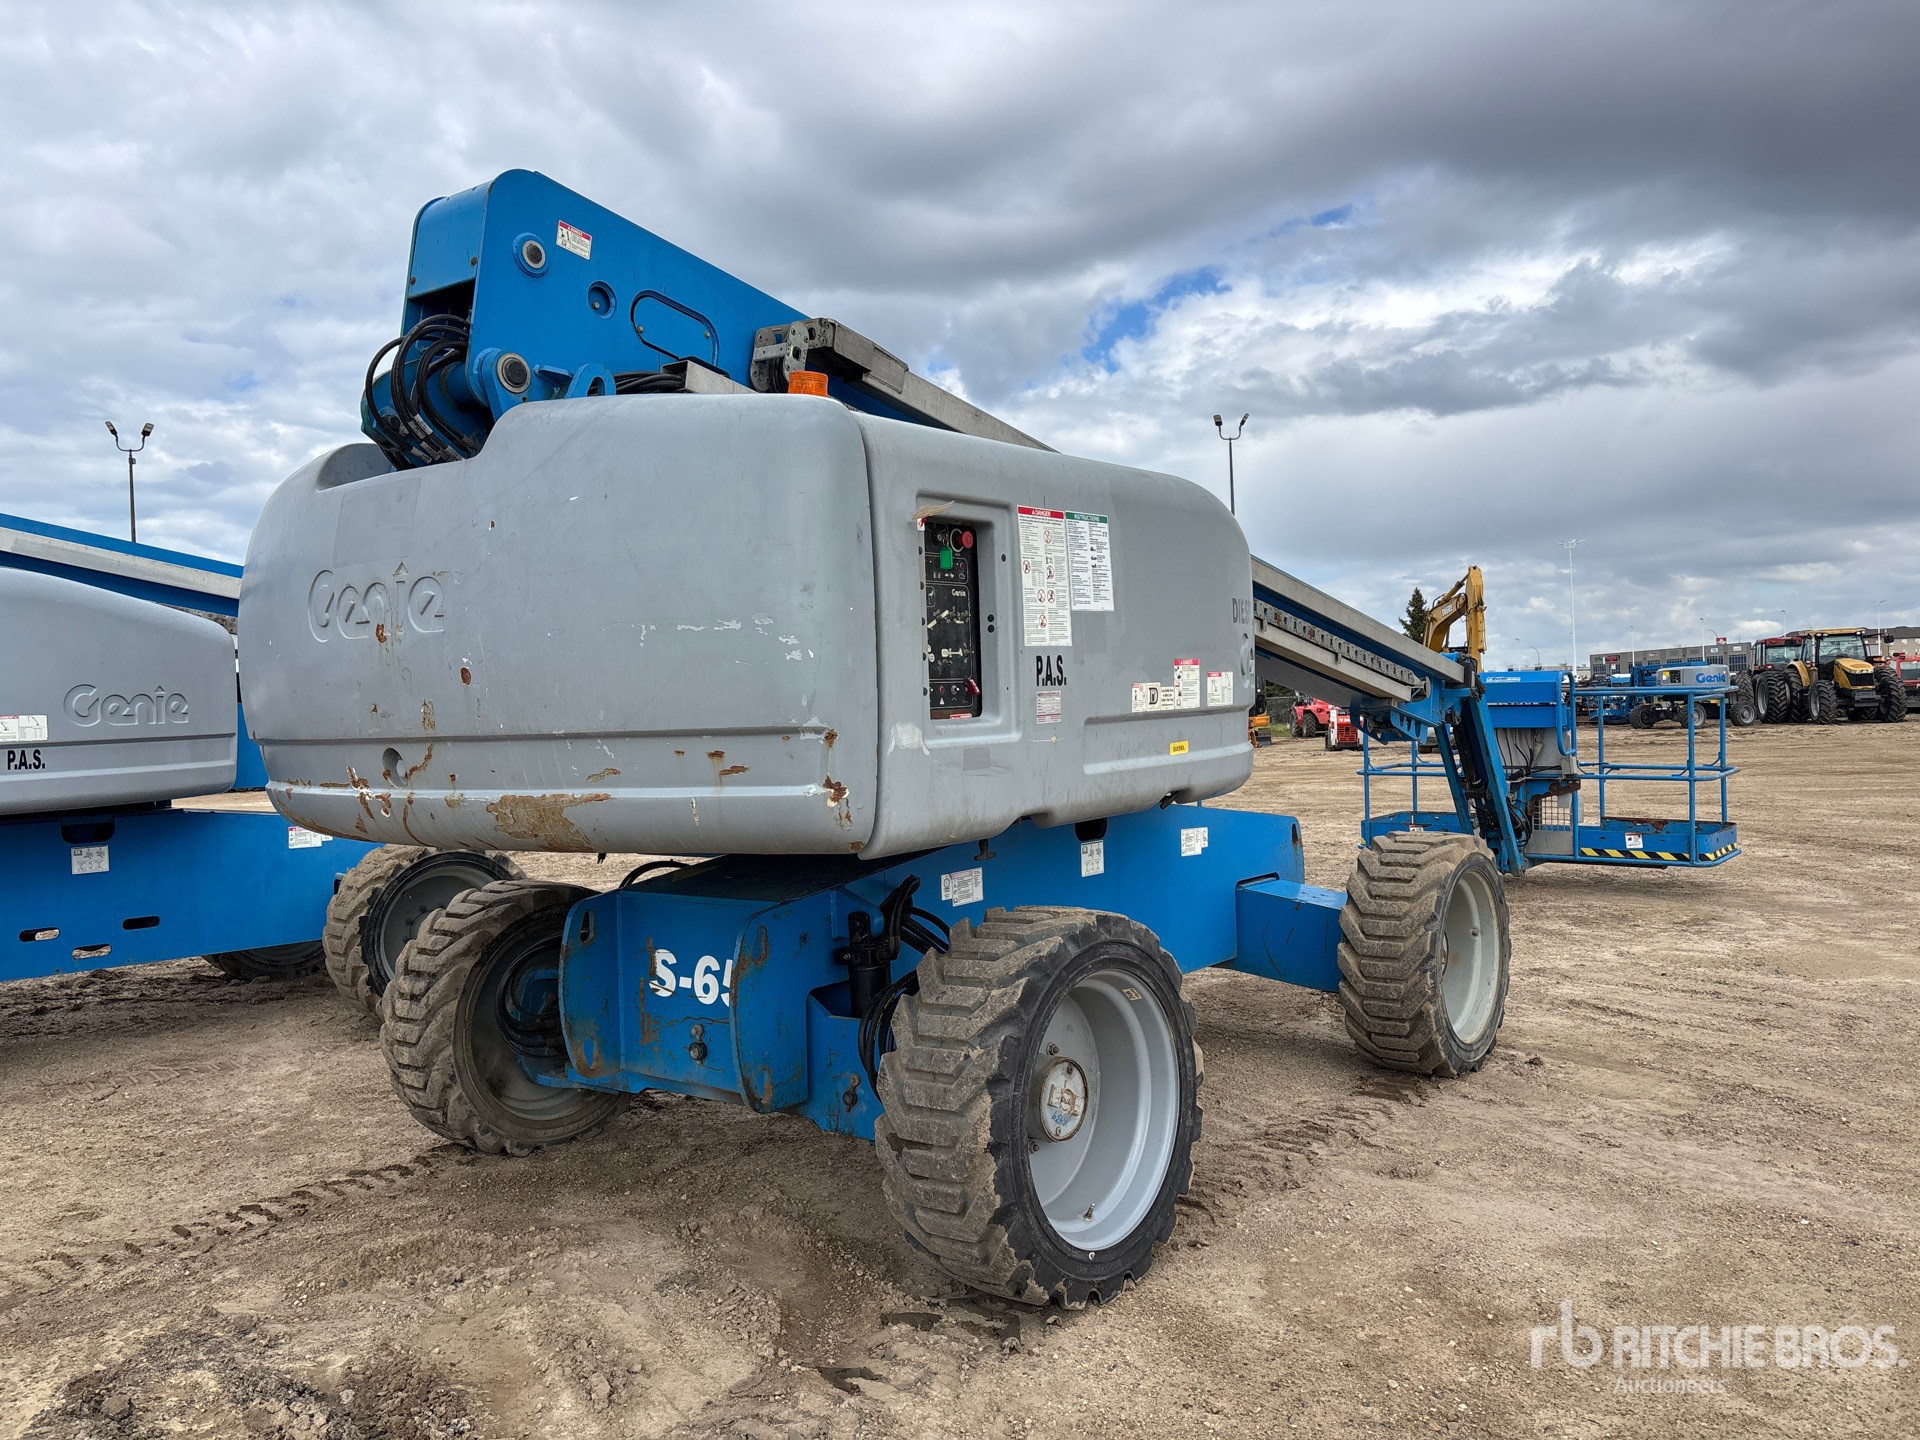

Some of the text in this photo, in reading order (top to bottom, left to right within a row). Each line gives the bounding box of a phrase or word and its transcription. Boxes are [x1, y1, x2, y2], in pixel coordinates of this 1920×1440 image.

[1035, 509, 1051, 517] DANGER
[1073, 513, 1100, 522] INSTRUCTIONS
[308, 561, 445, 643] Genie
[1036, 654, 1067, 687] P.A.S.
[1695, 672, 1726, 684] Genie
[63, 684, 189, 727] Genie
[7, 749, 46, 770] P.A.S.
